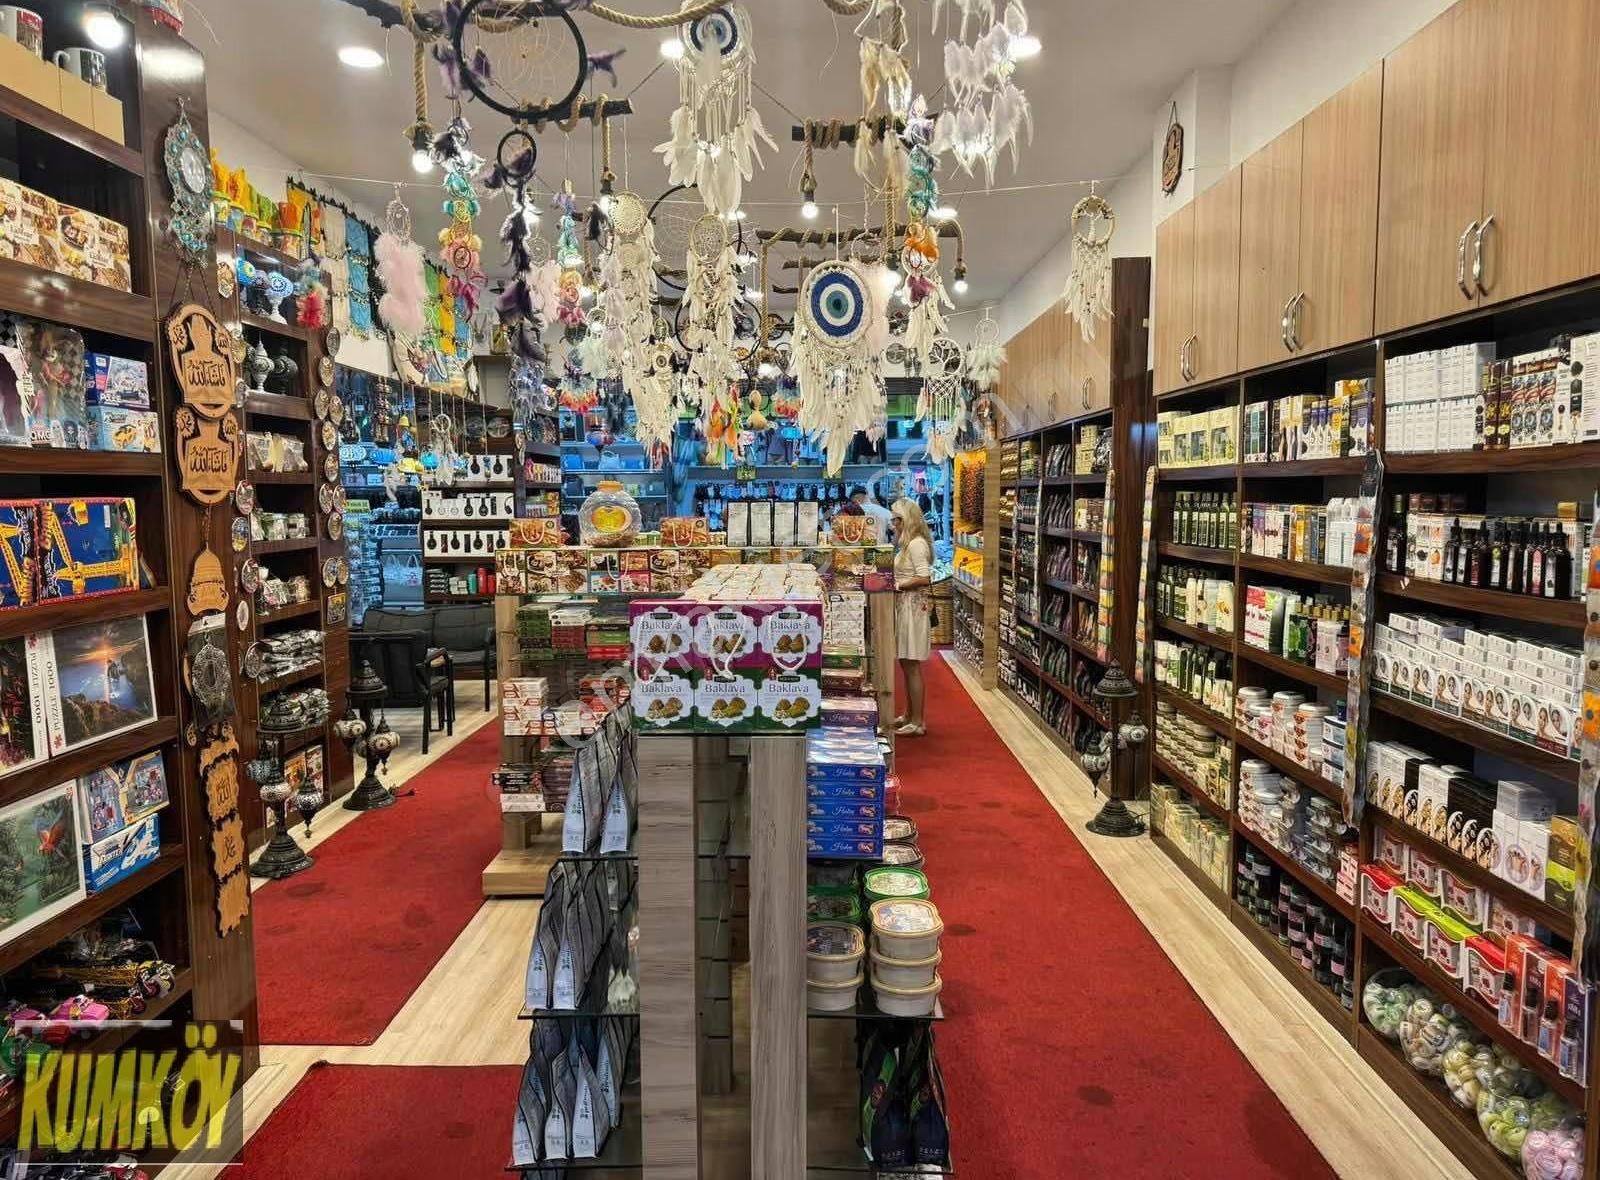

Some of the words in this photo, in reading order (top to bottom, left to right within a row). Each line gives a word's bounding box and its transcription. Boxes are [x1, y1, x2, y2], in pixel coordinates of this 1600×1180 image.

[641, 620, 682, 630] Baklaa
[770, 620, 810, 630] Baklaa
[46, 661, 55, 689] 1000
[641, 683, 682, 693] Baklava
[705, 683, 745, 693] Baklava
[768, 683, 809, 693] Baklava
[34, 695, 42, 724] 1000
